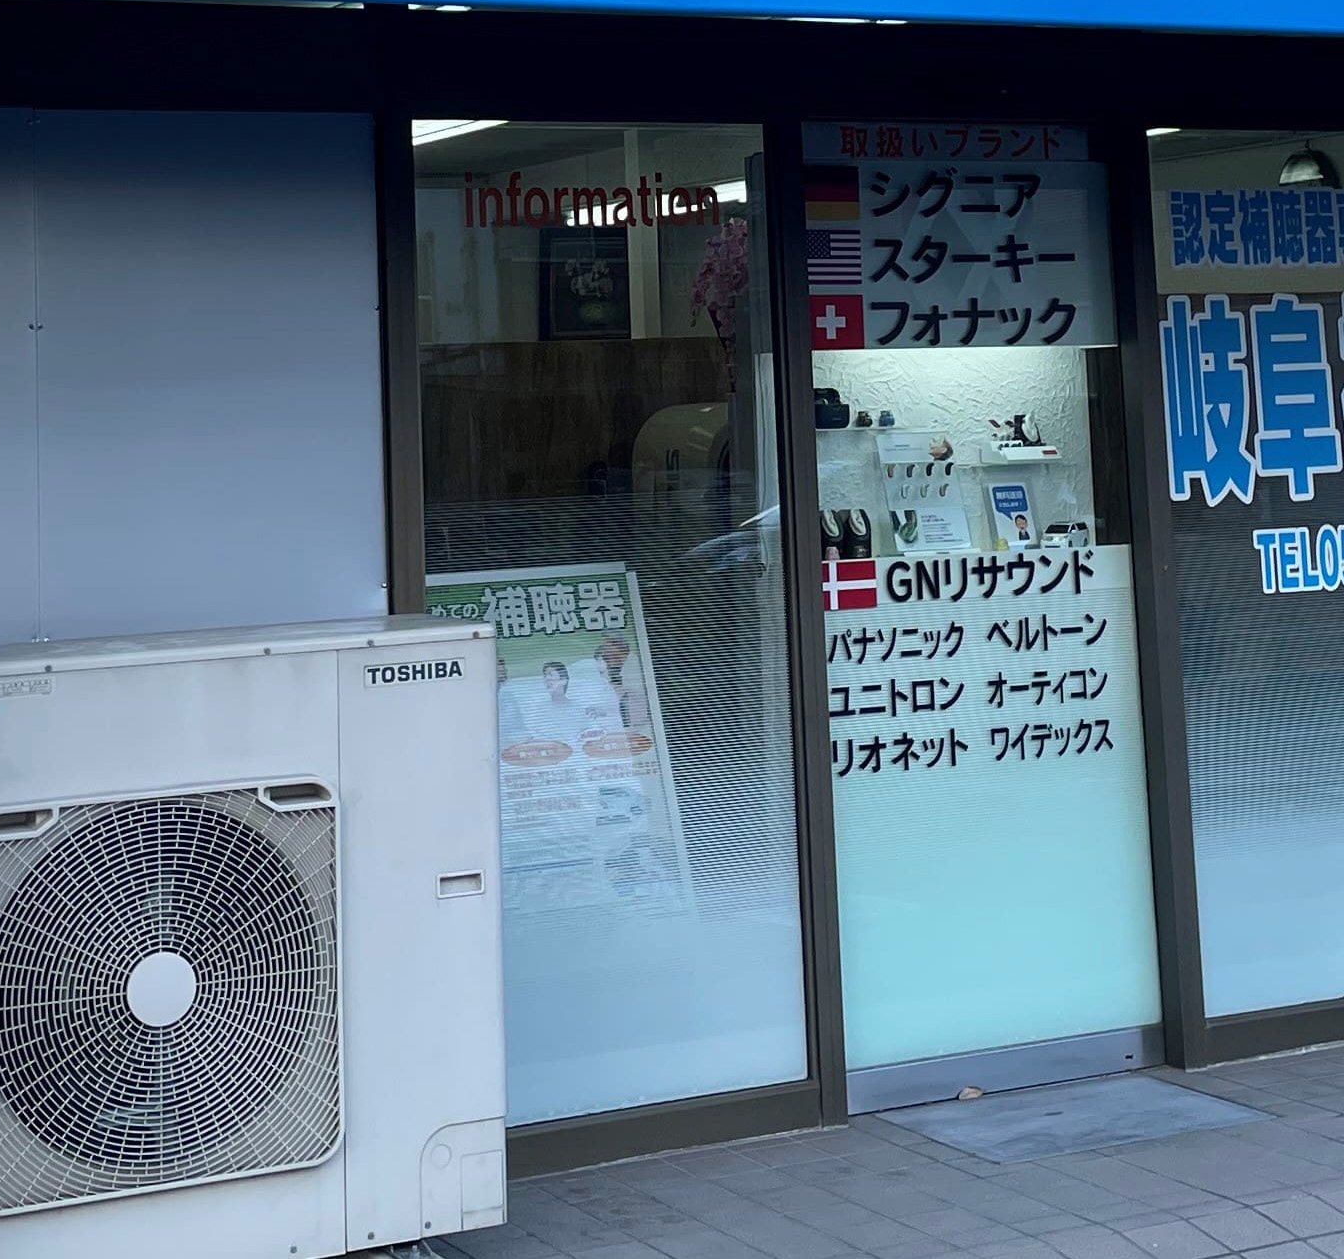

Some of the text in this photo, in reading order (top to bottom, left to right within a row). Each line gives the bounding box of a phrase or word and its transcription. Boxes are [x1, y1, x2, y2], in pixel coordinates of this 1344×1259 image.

[839, 125, 1061, 159] 取扱いブランド
[464, 172, 720, 228] information
[870, 167, 1041, 218] シグニア
[870, 234, 1076, 284] スターキー
[870, 297, 1077, 346] フォナック
[886, 550, 1095, 604] GNリサウンド
[828, 612, 1108, 665] パナソニック ベルトーン
[367, 660, 463, 685] TOSHIBA
[829, 667, 1109, 718] ユニトロン オーティコン
[832, 717, 1114, 777] リオネット ワイデックス
